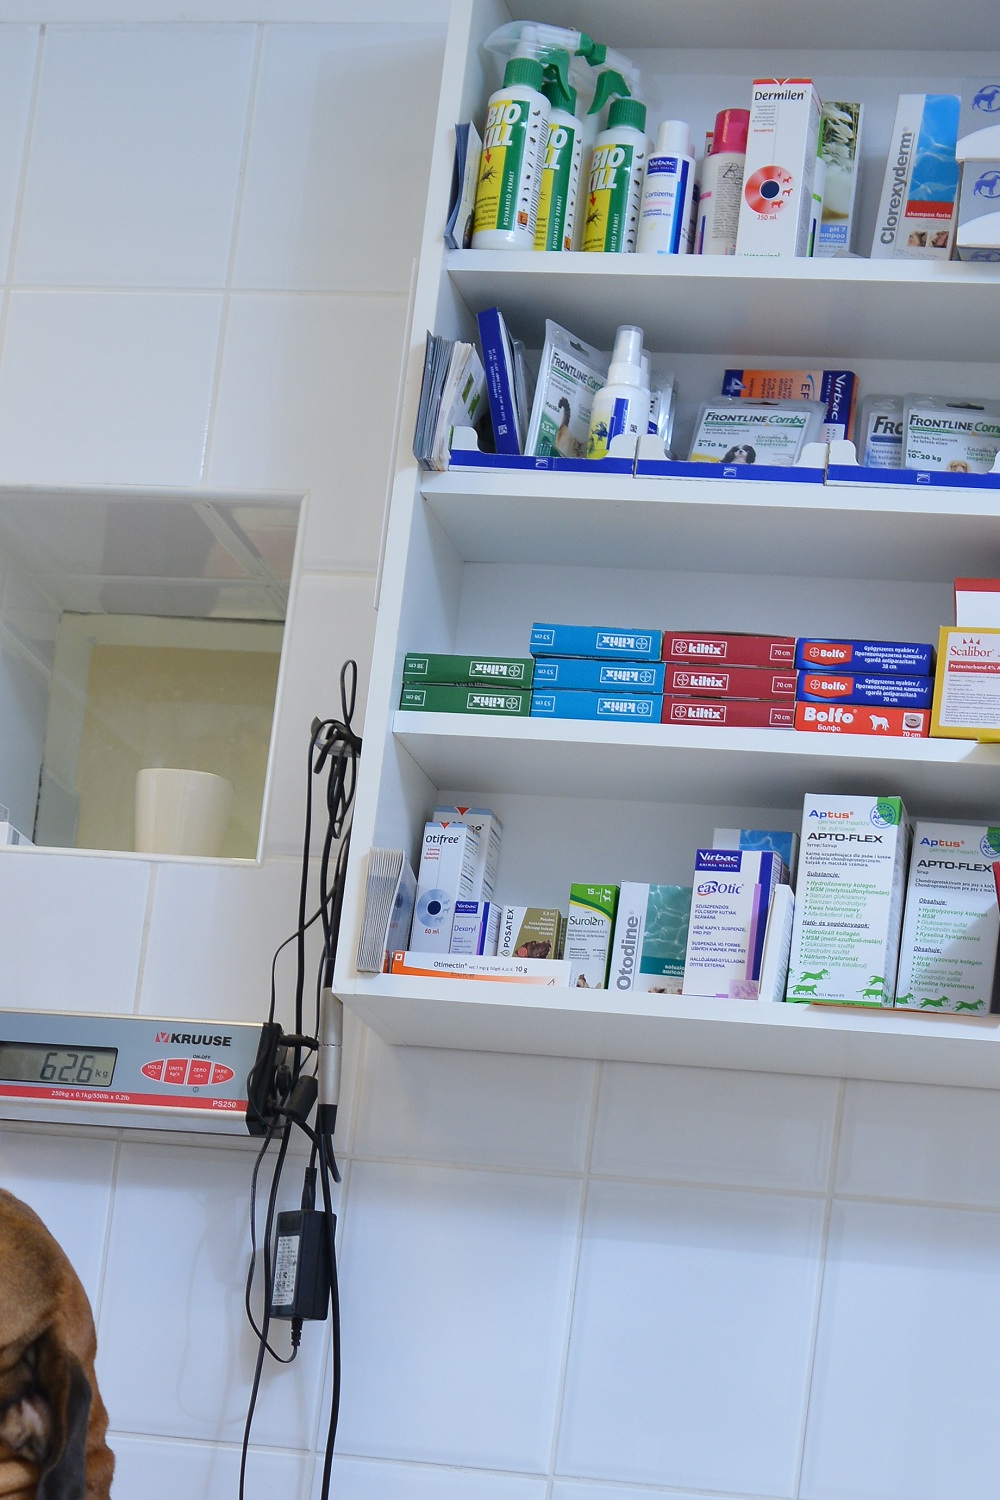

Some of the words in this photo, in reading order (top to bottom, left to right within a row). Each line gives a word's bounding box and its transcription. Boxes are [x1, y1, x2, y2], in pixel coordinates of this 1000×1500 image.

[754, 89, 805, 101] Dermilen
[486, 103, 521, 128] BIO
[592, 147, 625, 171] BIO
[648, 158, 676, 168] Virbac
[507, 171, 515, 191] PERMET
[880, 131, 913, 245] Clorexyderm
[503, 191, 512, 226] ROVARIRTÓ
[907, 211, 935, 219] shampoo
[612, 213, 620, 234] PERMET
[551, 352, 588, 384] FRONTLINE
[831, 373, 847, 422] Virbac
[705, 411, 768, 423] FRONTLINE
[769, 415, 806, 425] Combo
[909, 414, 973, 431] FRONTLINE
[907, 453, 931, 461] 10-20
[602, 635, 635, 648] kiltix
[688, 642, 721, 655] kiltix
[820, 648, 845, 659] Bolfo
[950, 645, 992, 658] Scalibor
[475, 663, 507, 676] kiltix
[605, 668, 639, 682] kiltix
[690, 674, 724, 687] kiltix
[822, 680, 847, 691] Bolfo
[472, 695, 504, 709] kiltix
[603, 700, 636, 714] kiltix
[688, 706, 721, 719] kiltix
[804, 707, 854, 724] Bolfo
[817, 723, 841, 732] Болфо
[808, 809, 850, 819] Aptus
[425, 834, 459, 846] Otifree
[807, 832, 883, 844] APTO-FLEX
[920, 837, 961, 848] Aptus
[699, 852, 739, 862] Virbac
[917, 859, 993, 873] APTO-FLEX
[697, 881, 742, 896] easOtic
[569, 915, 605, 926] Surolan
[454, 924, 477, 934] Dexoryl
[504, 908, 515, 948] POSATEX
[616, 915, 639, 991] Otodine
[434, 961, 465, 969] Otimectin
[170, 1032, 232, 1047] KRUUSE
[95, 1069, 109, 1080] kg
[51, 1090, 69, 1098] 250kg
[212, 1100, 236, 1109] PS250
